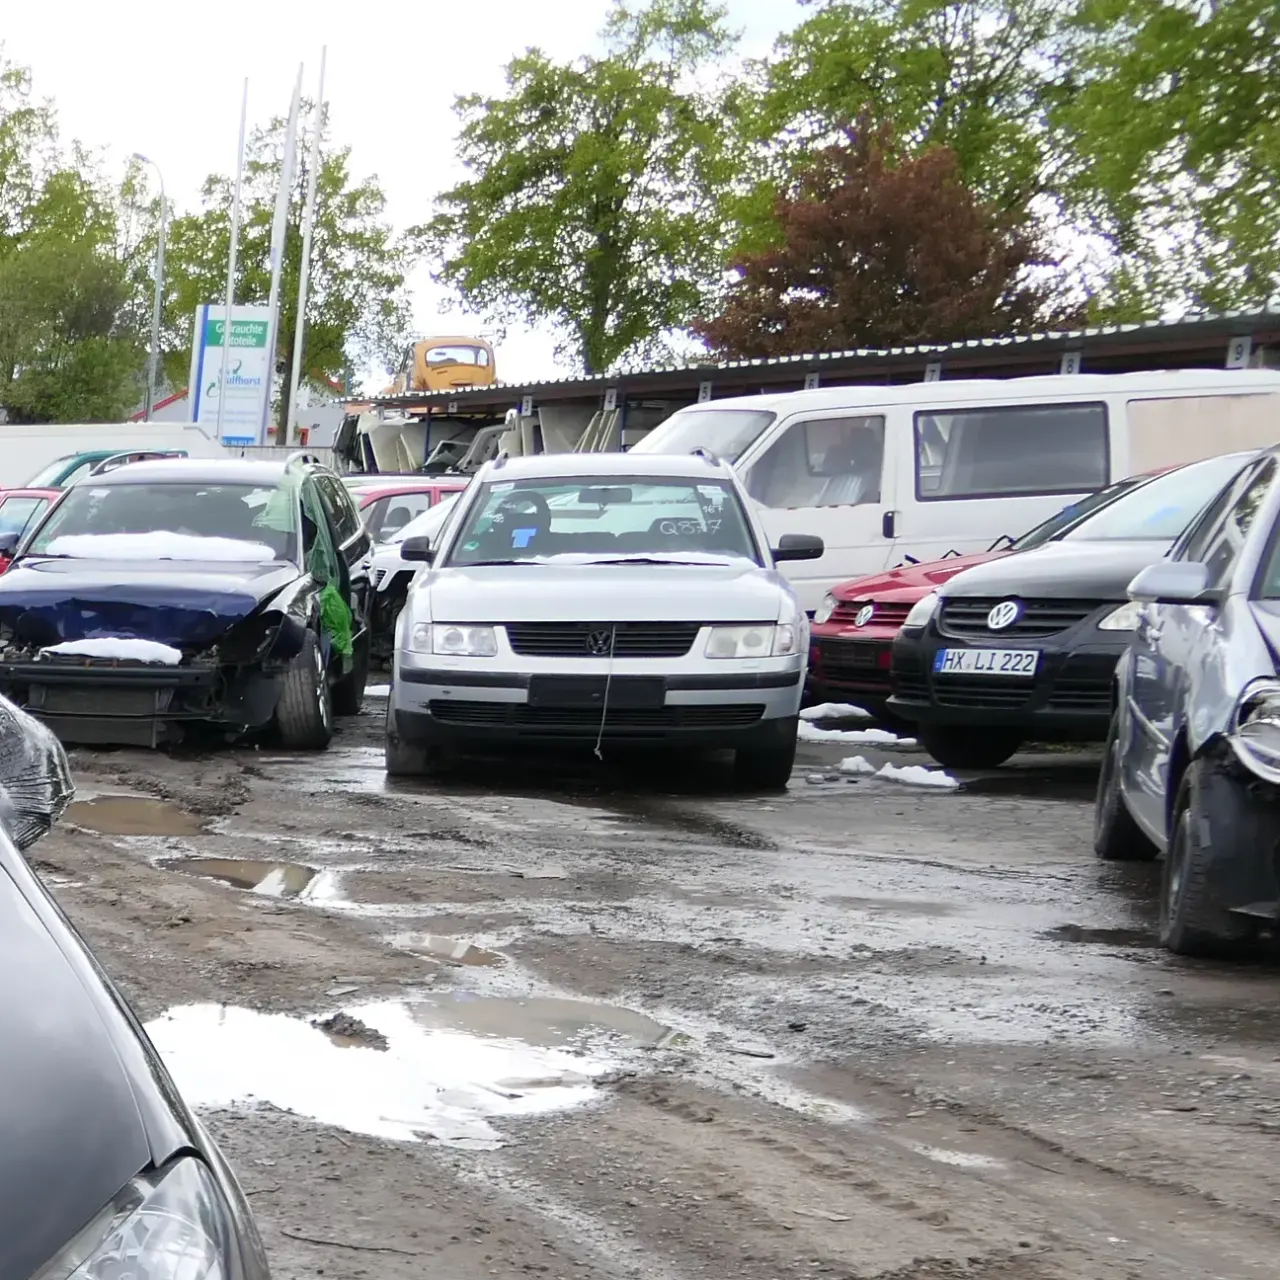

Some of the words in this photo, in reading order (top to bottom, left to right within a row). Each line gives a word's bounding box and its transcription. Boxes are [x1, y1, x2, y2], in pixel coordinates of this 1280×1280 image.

[215, 322, 265, 335] Grauchte
[217, 376, 261, 386] ulfhorst
[943, 651, 967, 670] HX
[974, 653, 994, 670] LI
[999, 653, 1036, 672] 222
